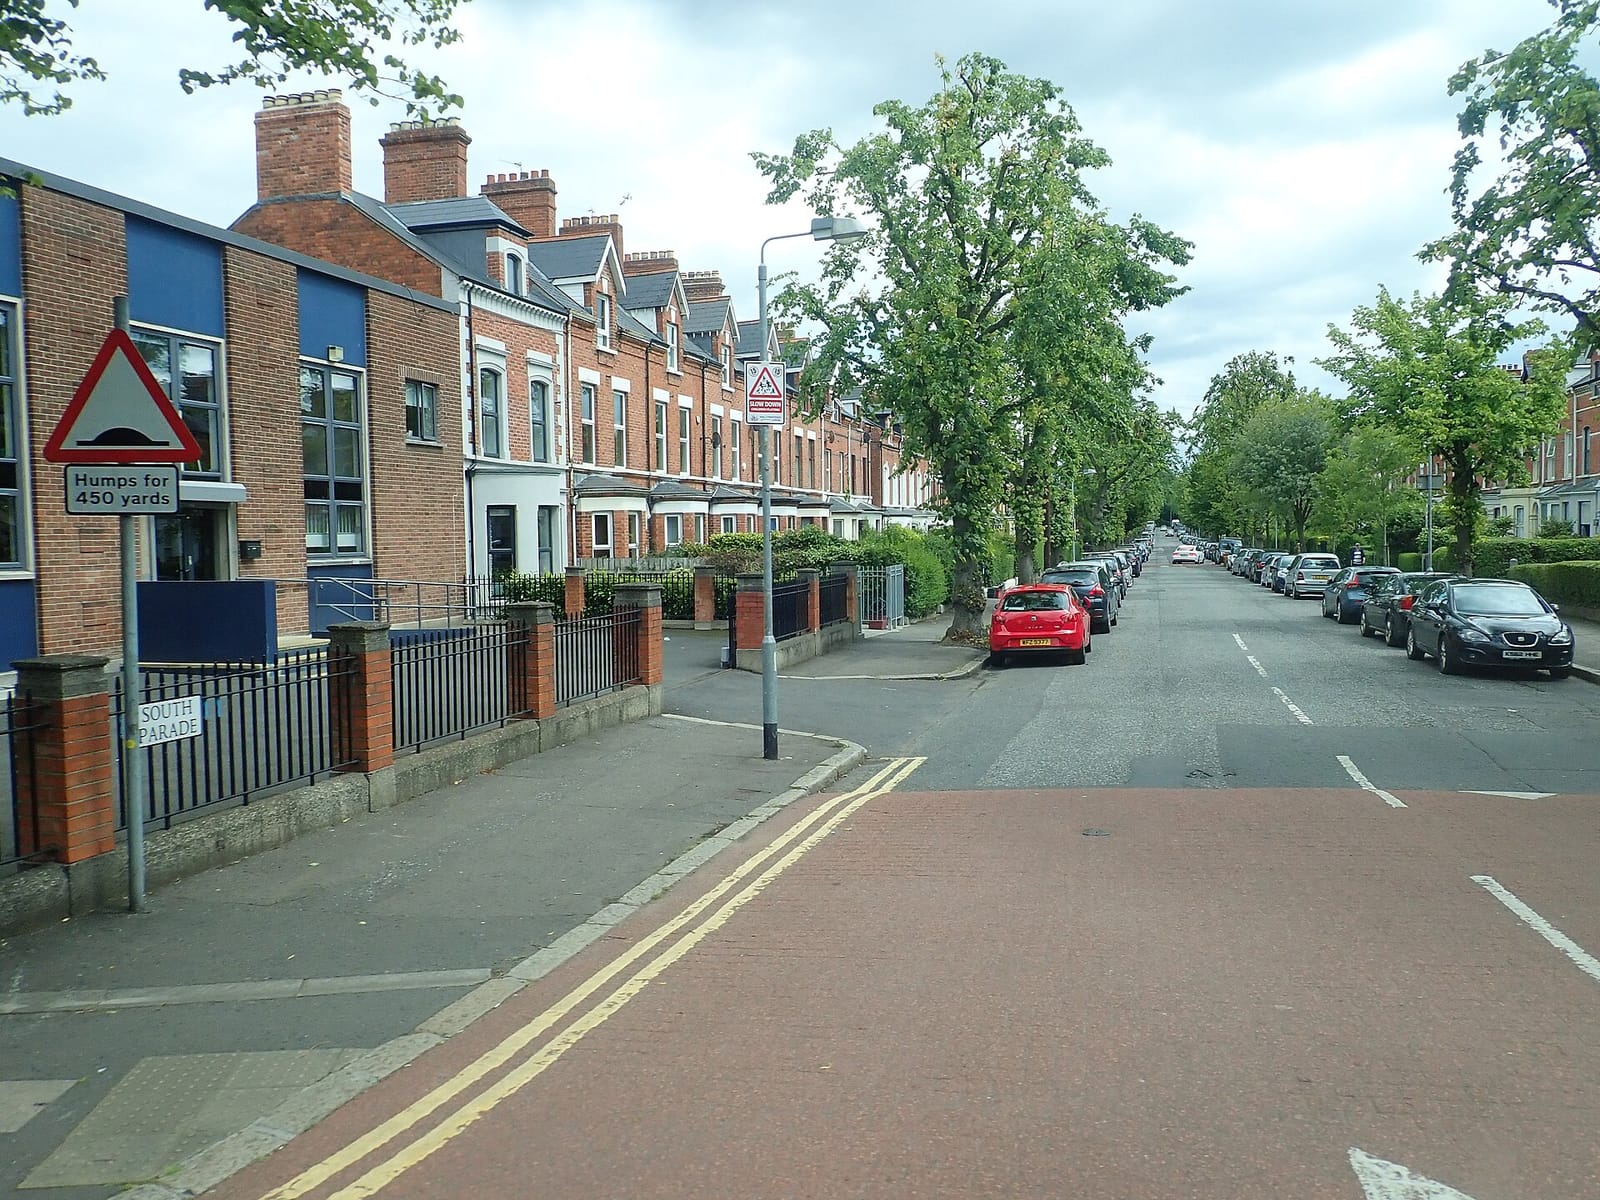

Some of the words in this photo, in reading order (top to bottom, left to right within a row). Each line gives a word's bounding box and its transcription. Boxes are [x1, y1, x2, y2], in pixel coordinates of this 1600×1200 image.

[75, 473, 137, 489] Humps
[143, 474, 169, 487] for
[76, 491, 114, 505] 450
[121, 491, 170, 507] yards
[142, 699, 192, 722] SOUTH
[139, 718, 197, 744] PARADE
